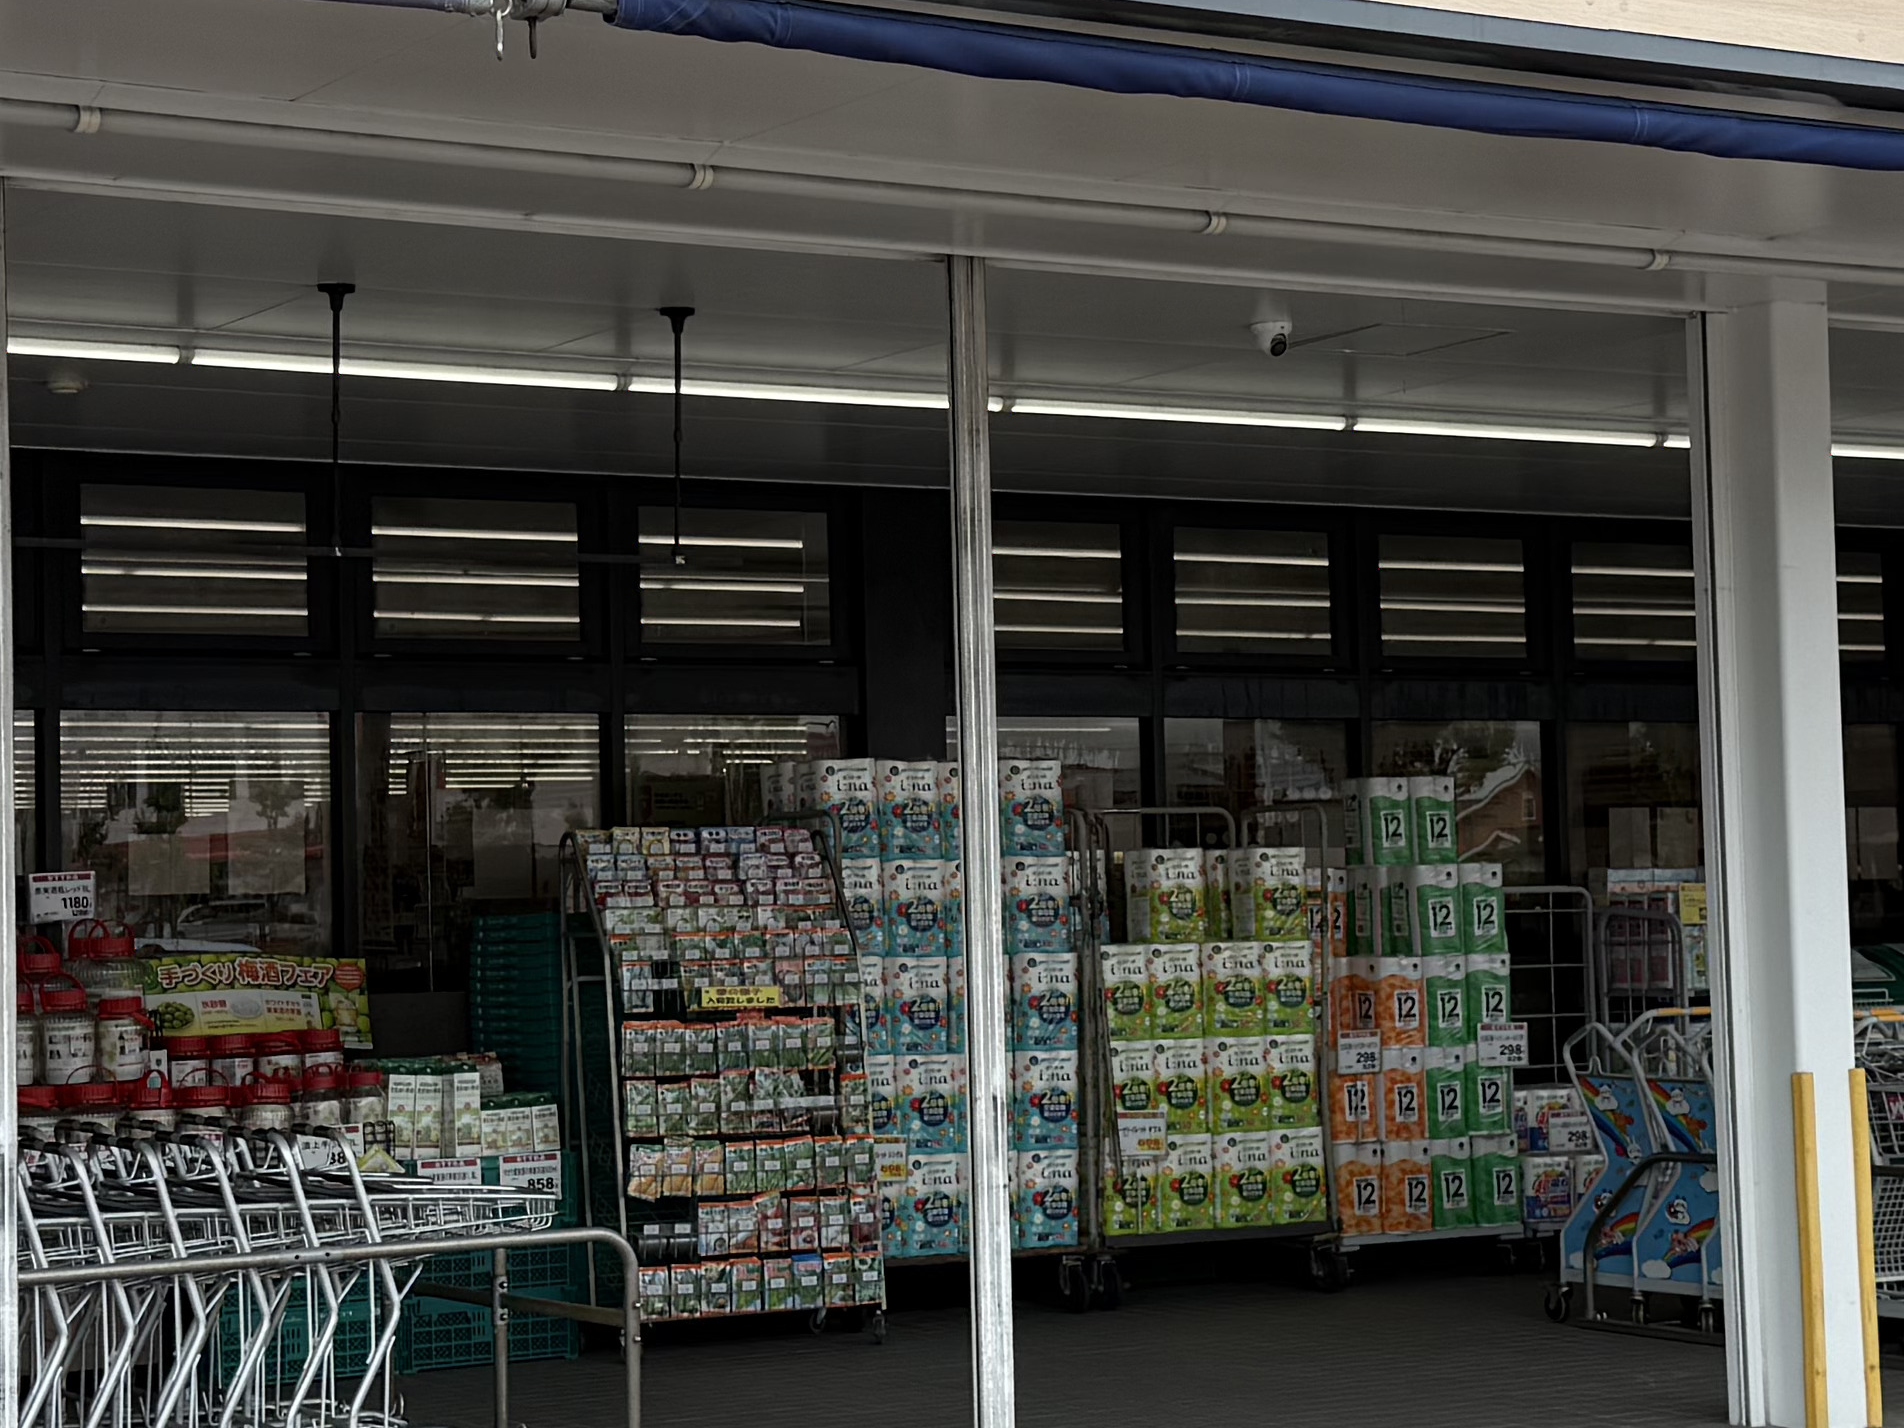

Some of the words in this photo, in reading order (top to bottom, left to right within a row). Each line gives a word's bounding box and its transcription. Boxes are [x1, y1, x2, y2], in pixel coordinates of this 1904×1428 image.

[1384, 816, 1402, 842] 12
[1429, 817, 1448, 842] 12
[61, 896, 89, 909] 1180
[1432, 904, 1453, 930] 12
[1477, 903, 1496, 929] 12
[157, 957, 334, 989] 手づくり梅酒フェア
[1359, 996, 1372, 1019] 12
[1397, 996, 1416, 1021] 12
[1439, 995, 1459, 1021] 12
[1485, 991, 1504, 1017] 12
[1356, 1051, 1376, 1064] 298
[1500, 1043, 1522, 1056] 298
[1398, 1089, 1415, 1116] 12
[1440, 1088, 1458, 1116] 12
[1481, 1082, 1500, 1108] 12
[1568, 1130, 1587, 1143] 298
[527, 1177, 555, 1190] 858
[1356, 1182, 1376, 1210] 12
[1408, 1181, 1426, 1209] 12
[1445, 1176, 1464, 1203] 12
[1496, 1173, 1514, 1199] 12
